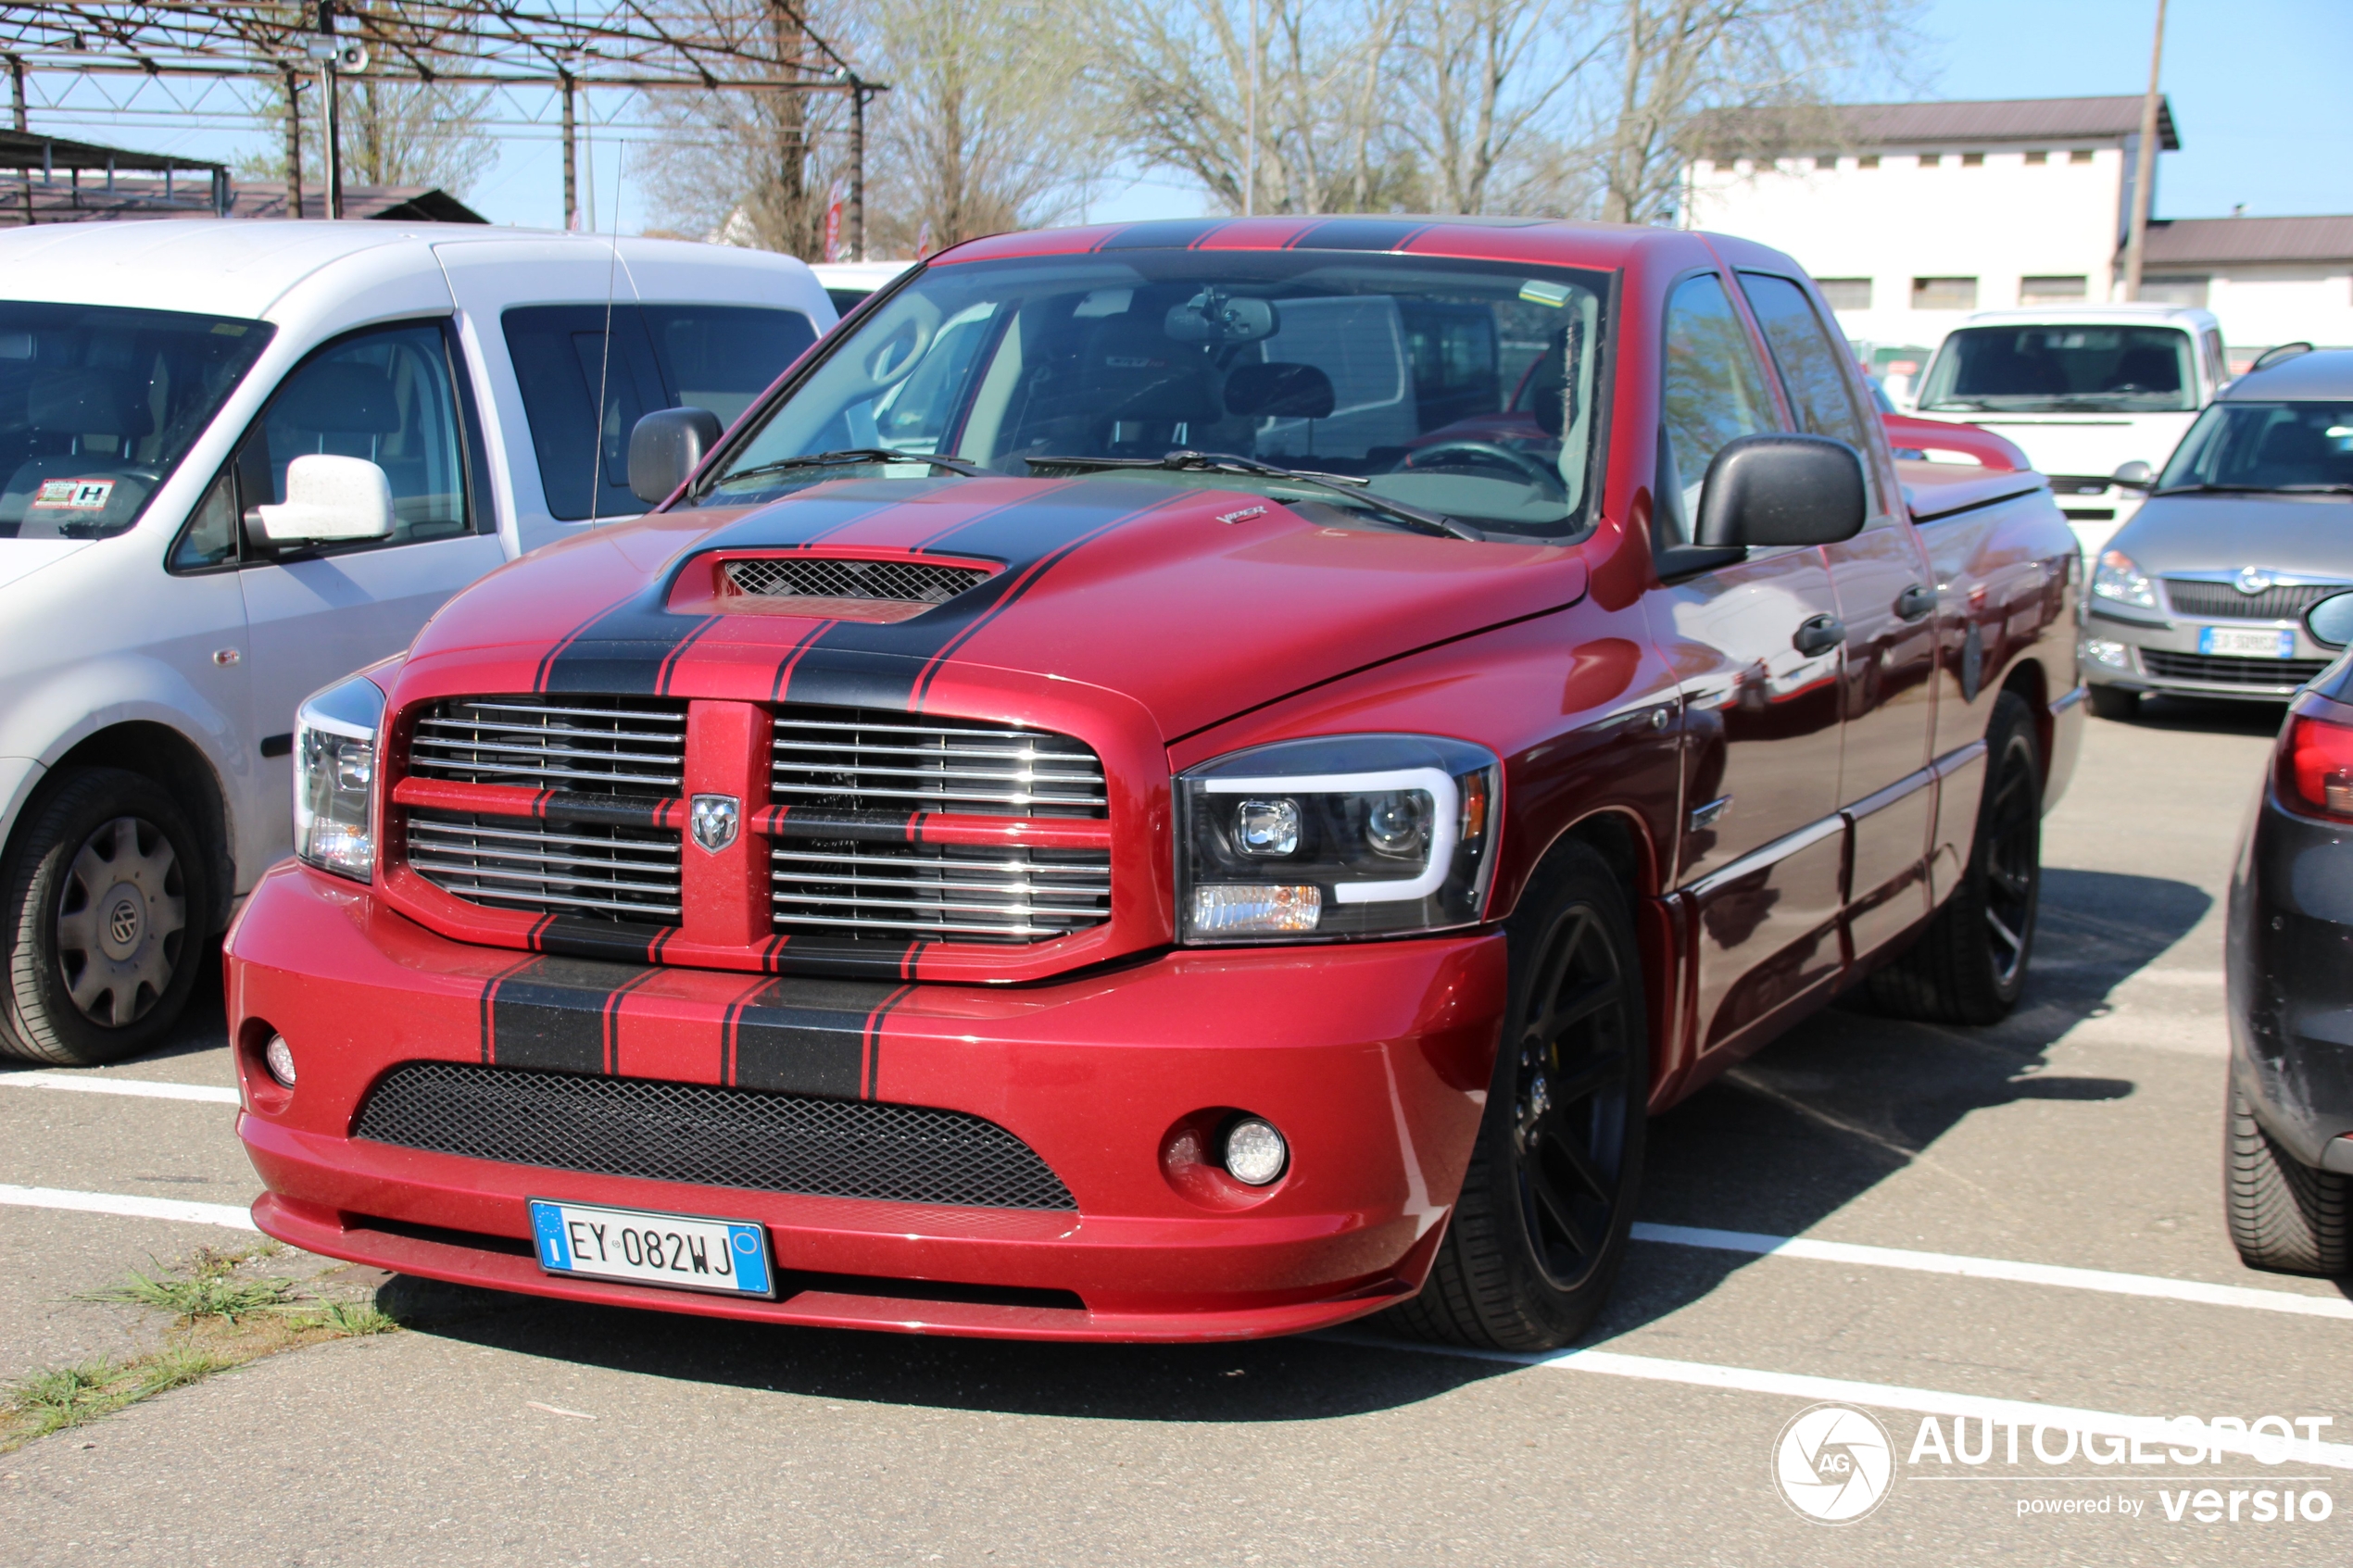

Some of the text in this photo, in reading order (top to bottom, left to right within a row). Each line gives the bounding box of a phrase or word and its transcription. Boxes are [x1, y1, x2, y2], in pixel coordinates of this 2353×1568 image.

[79, 486, 104, 501] H
[1215, 506, 1268, 525] VIPER
[568, 1221, 733, 1275] EY 082WJ
